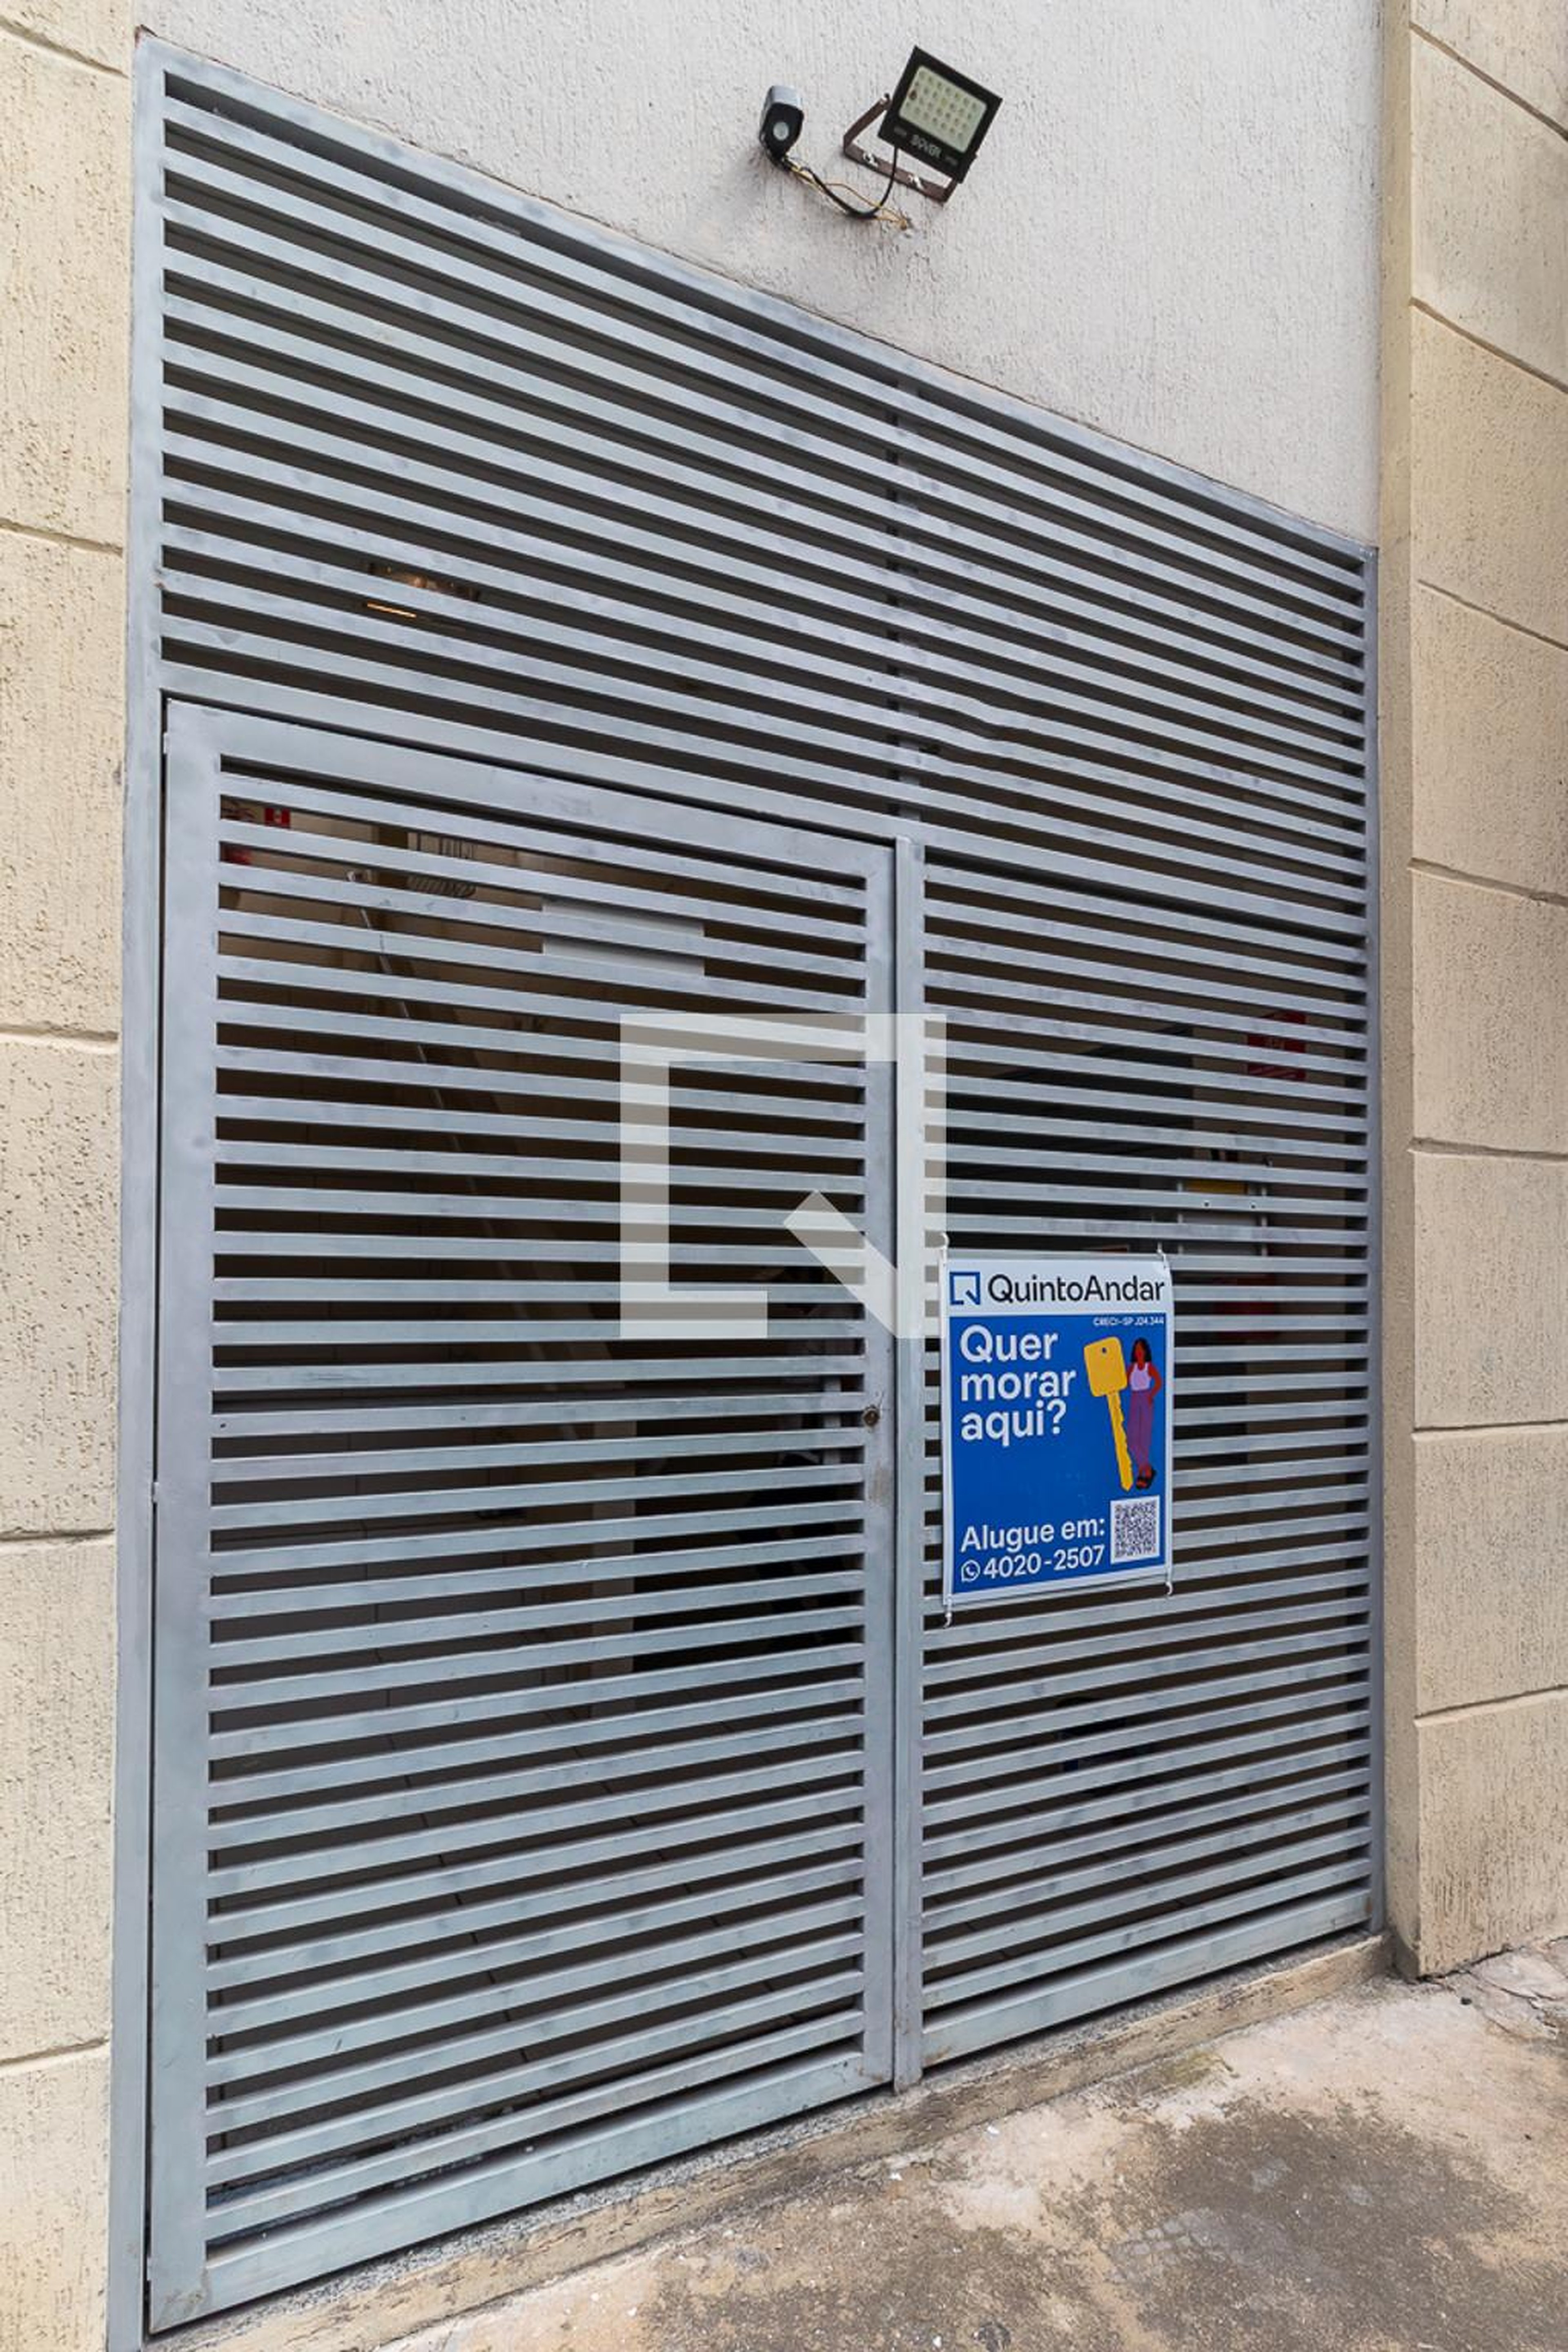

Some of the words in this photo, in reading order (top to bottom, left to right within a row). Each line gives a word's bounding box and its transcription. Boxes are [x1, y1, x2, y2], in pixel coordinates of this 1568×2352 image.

[988, 1274, 1165, 1303] QuintoAndar
[960, 1325, 1058, 1363] Quer
[961, 1370, 1076, 1401] morar
[961, 1398, 1067, 1447] aqui?
[960, 1524, 1055, 1553] Alugue
[1061, 1518, 1105, 1540] em:
[983, 1544, 1105, 1579] 4020-2507
